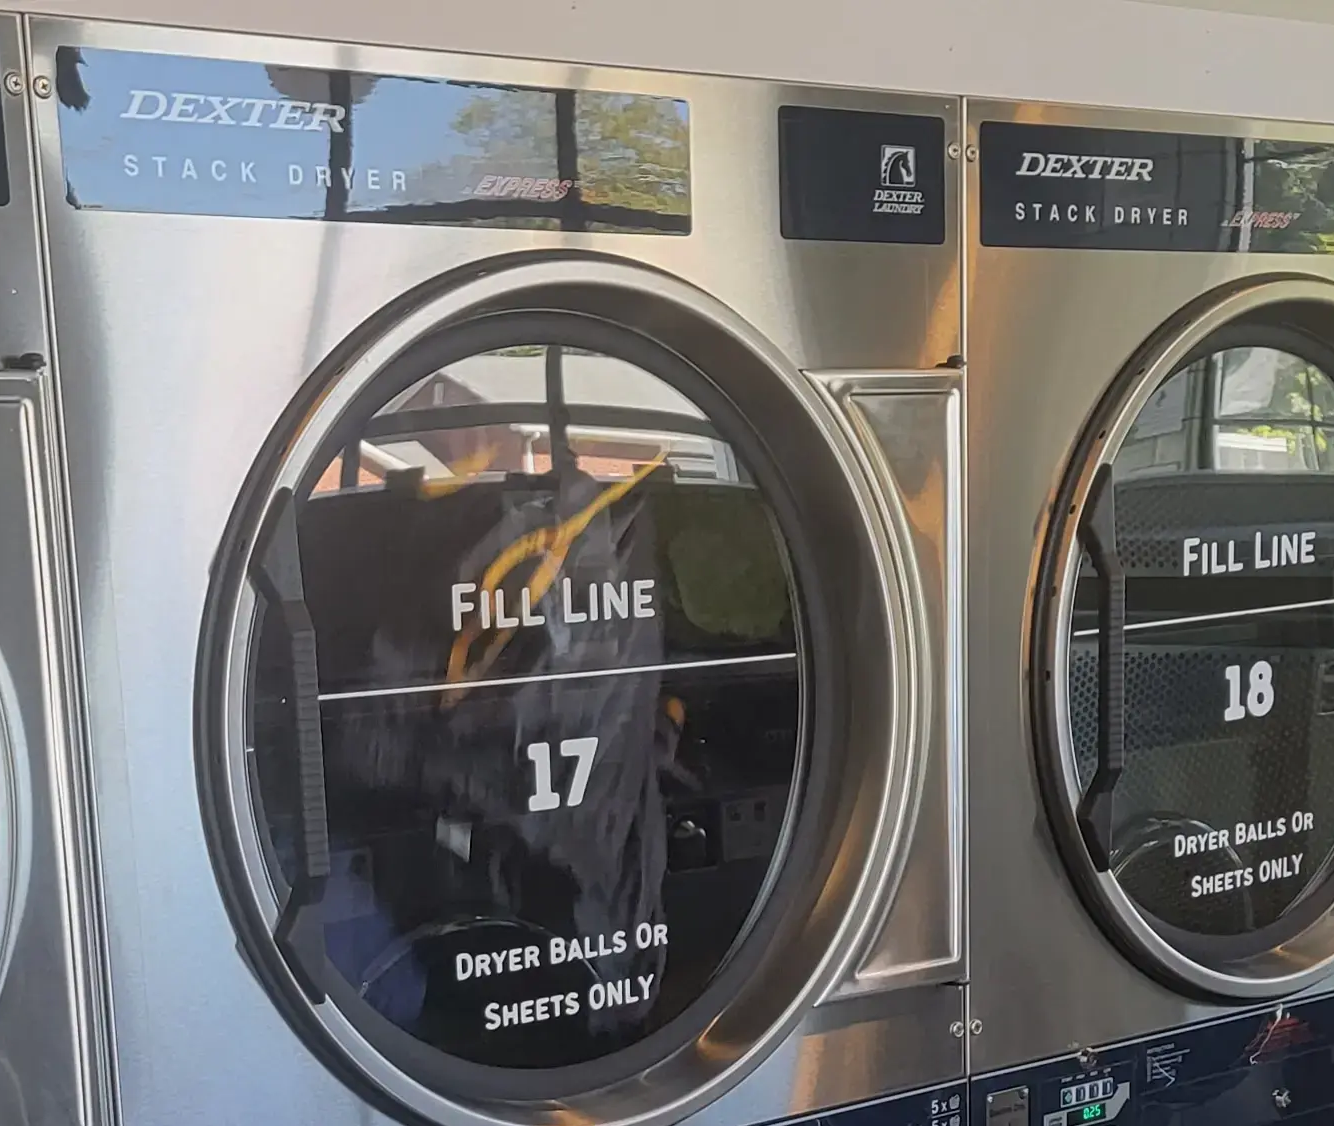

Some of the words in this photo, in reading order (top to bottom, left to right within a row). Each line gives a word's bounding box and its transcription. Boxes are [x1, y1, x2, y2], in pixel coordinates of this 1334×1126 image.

[119, 90, 346, 132] DEXTER
[122, 153, 258, 184] STACK
[288, 164, 407, 193] DRYER
[473, 174, 574, 201] EXPRESS
[1015, 151, 1154, 183] DEXTER
[873, 189, 924, 203] DEXTER
[1015, 202, 1097, 224] STACK
[1114, 205, 1189, 226] DRYER
[1230, 211, 1293, 228] EXPRESS
[1182, 537, 1244, 577] FILL
[1254, 530, 1316, 569] LINE
[451, 582, 546, 631] FILL
[563, 577, 656, 624] LINE
[1223, 659, 1275, 722] 18
[527, 736, 599, 812] 17
[1174, 829, 1229, 858] DRYER
[1235, 819, 1287, 844] BALLS
[1291, 810, 1314, 832] OR
[1190, 868, 1254, 898] SHEETS
[1259, 853, 1304, 882] ONLY
[455, 944, 540, 981] DRYER
[549, 931, 628, 965] BALLS
[635, 922, 669, 949] OR
[483, 991, 581, 1031] SHEETS
[589, 973, 655, 1008] ONLY
[931, 1099, 939, 1115] 5
